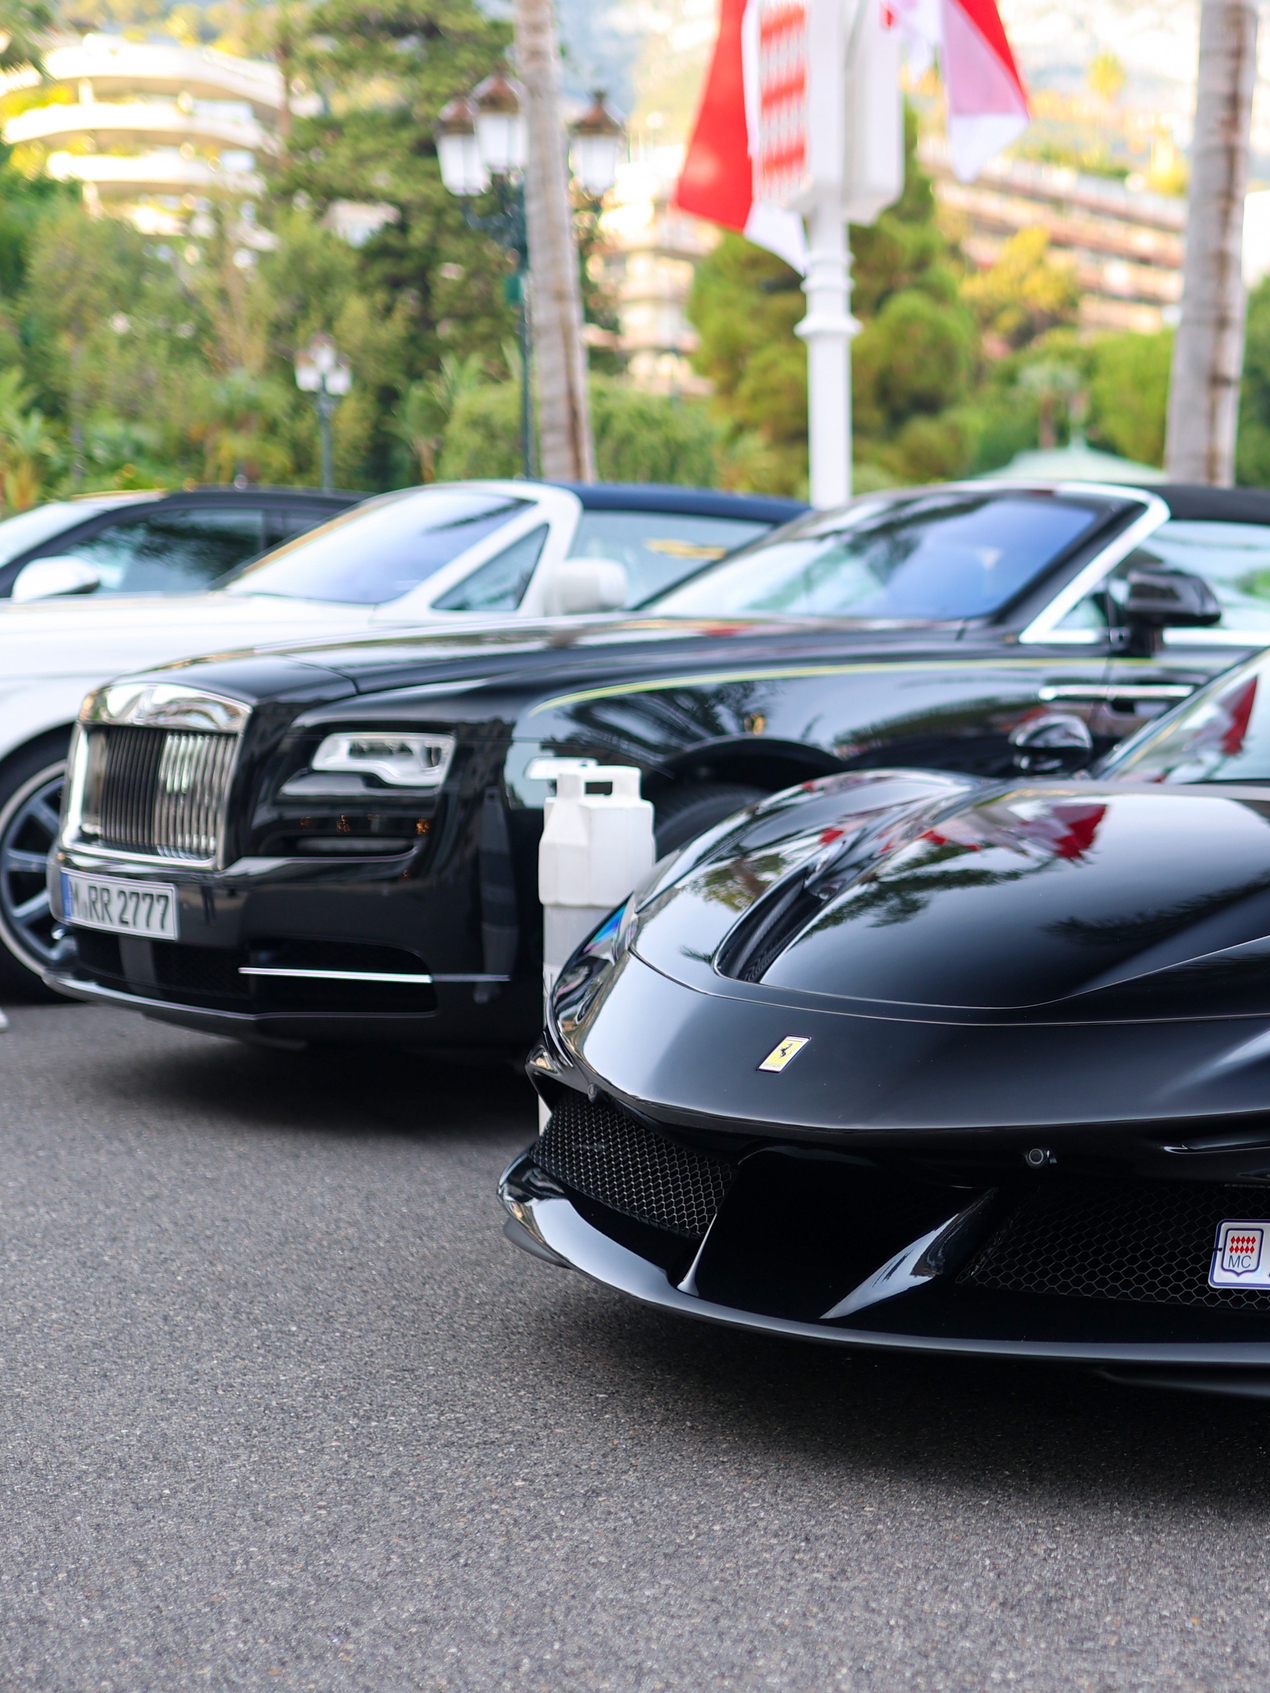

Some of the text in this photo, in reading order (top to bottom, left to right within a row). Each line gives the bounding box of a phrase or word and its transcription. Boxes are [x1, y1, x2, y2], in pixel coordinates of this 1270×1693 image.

[88, 885, 113, 923] RR
[117, 890, 169, 930] 2777
[1228, 1255, 1251, 1269] MC
